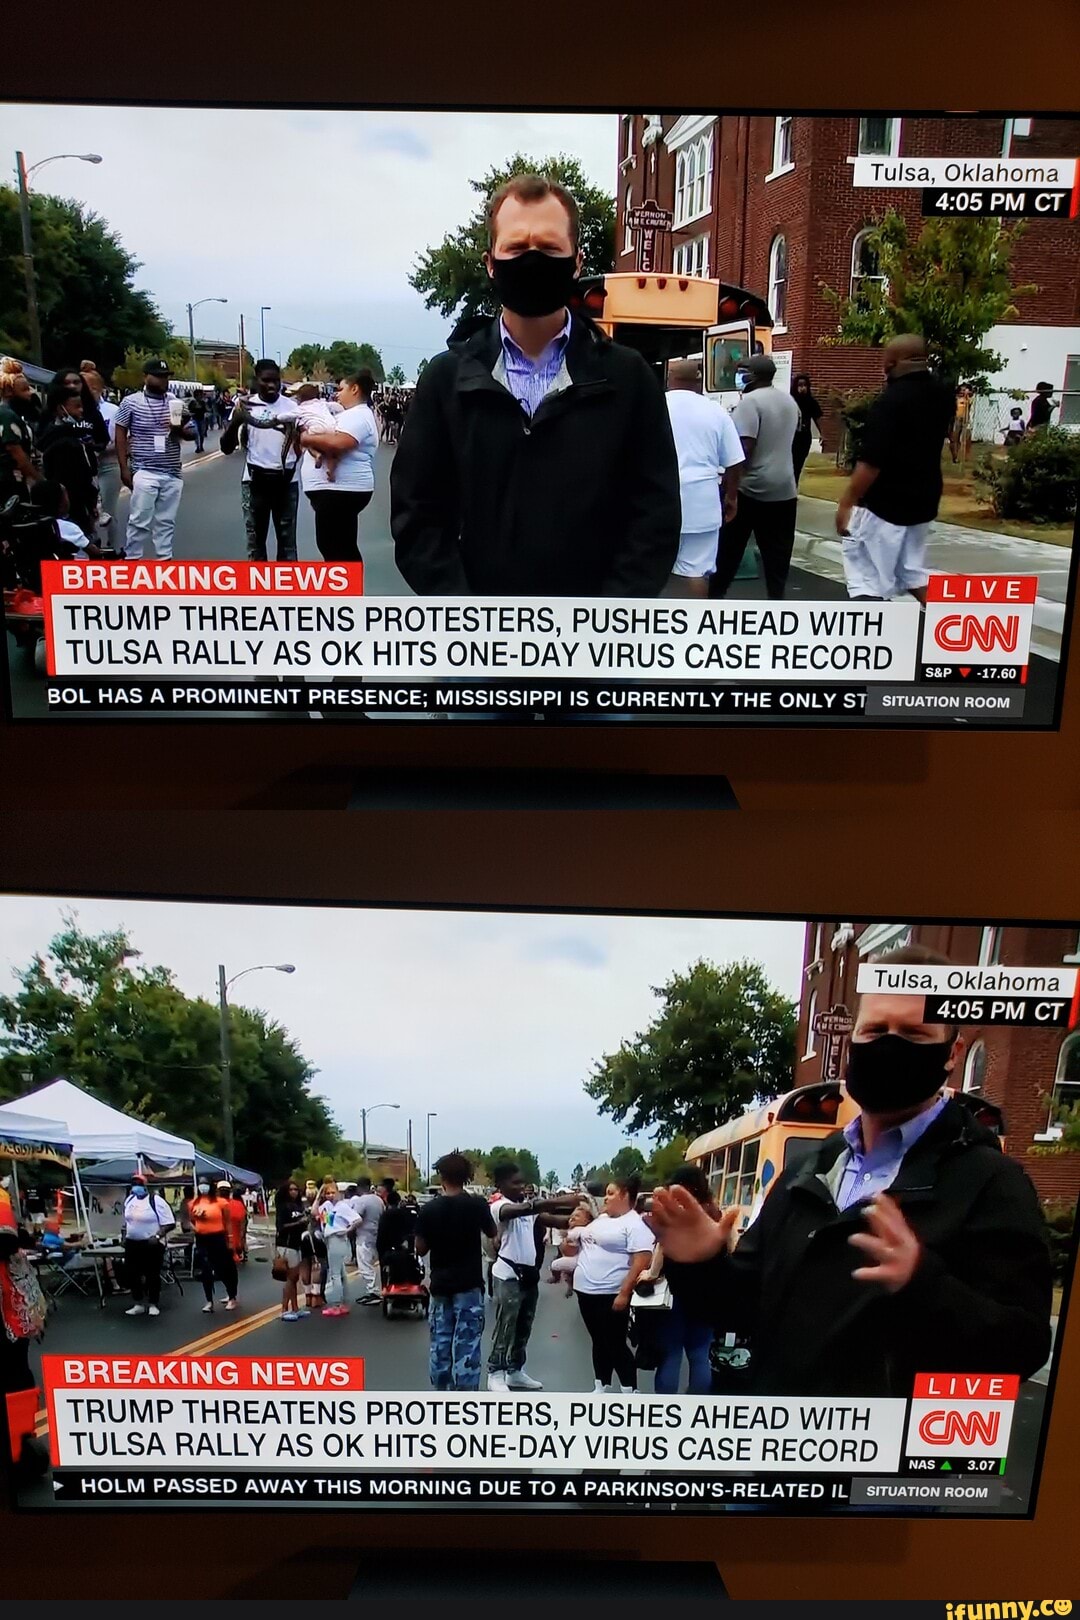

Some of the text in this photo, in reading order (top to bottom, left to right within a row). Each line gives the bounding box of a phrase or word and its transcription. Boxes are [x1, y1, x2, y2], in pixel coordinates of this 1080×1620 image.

[871, 163, 1058, 184] Tulsa, Oklahoma
[936, 193, 1065, 211] 4:05 PM CT
[634, 209, 666, 219] VERNON
[63, 566, 348, 590] BREAKING NEWS
[943, 580, 1020, 598] LIVE
[64, 606, 883, 637] TRUMP THREATENS PROTESTERS, PUSHES AHEAD WITH
[935, 615, 1019, 652] CNN
[66, 639, 892, 669] TULSA RALLY AS OK HITS ONE-DAY VIRUS CASE RECORD
[926, 668, 1016, 678] S&P -17.60
[48, 688, 866, 708] BOL HAS A PROMINENT PRESENCE; MISSISSIPPI IS CURRENTLY THE ONLY ST
[883, 696, 1009, 708] SITUATION ROOM
[875, 970, 1059, 992] Tulsa, Oklahoma
[937, 1001, 1064, 1020] 4:05 PM CT
[64, 1361, 349, 1385] BREAKING NEWS
[929, 1378, 1003, 1395] LIVE
[67, 1399, 870, 1430] TRUMP THREATENS PROTESTERS, PUSHES AHEAD WITH
[919, 1410, 1000, 1446] CNN
[69, 1432, 878, 1462] TULSA RALLY AS OK HITS ONE-DAY VIRUS CASE RECORD
[909, 1460, 995, 1470] NAS 3.07
[82, 1479, 848, 1498] HOLM PASSED AWAY THIS MORNING DUE TO A PARKINSON'S-RELATED IL
[866, 1485, 989, 1498] SITUATION ROOM
